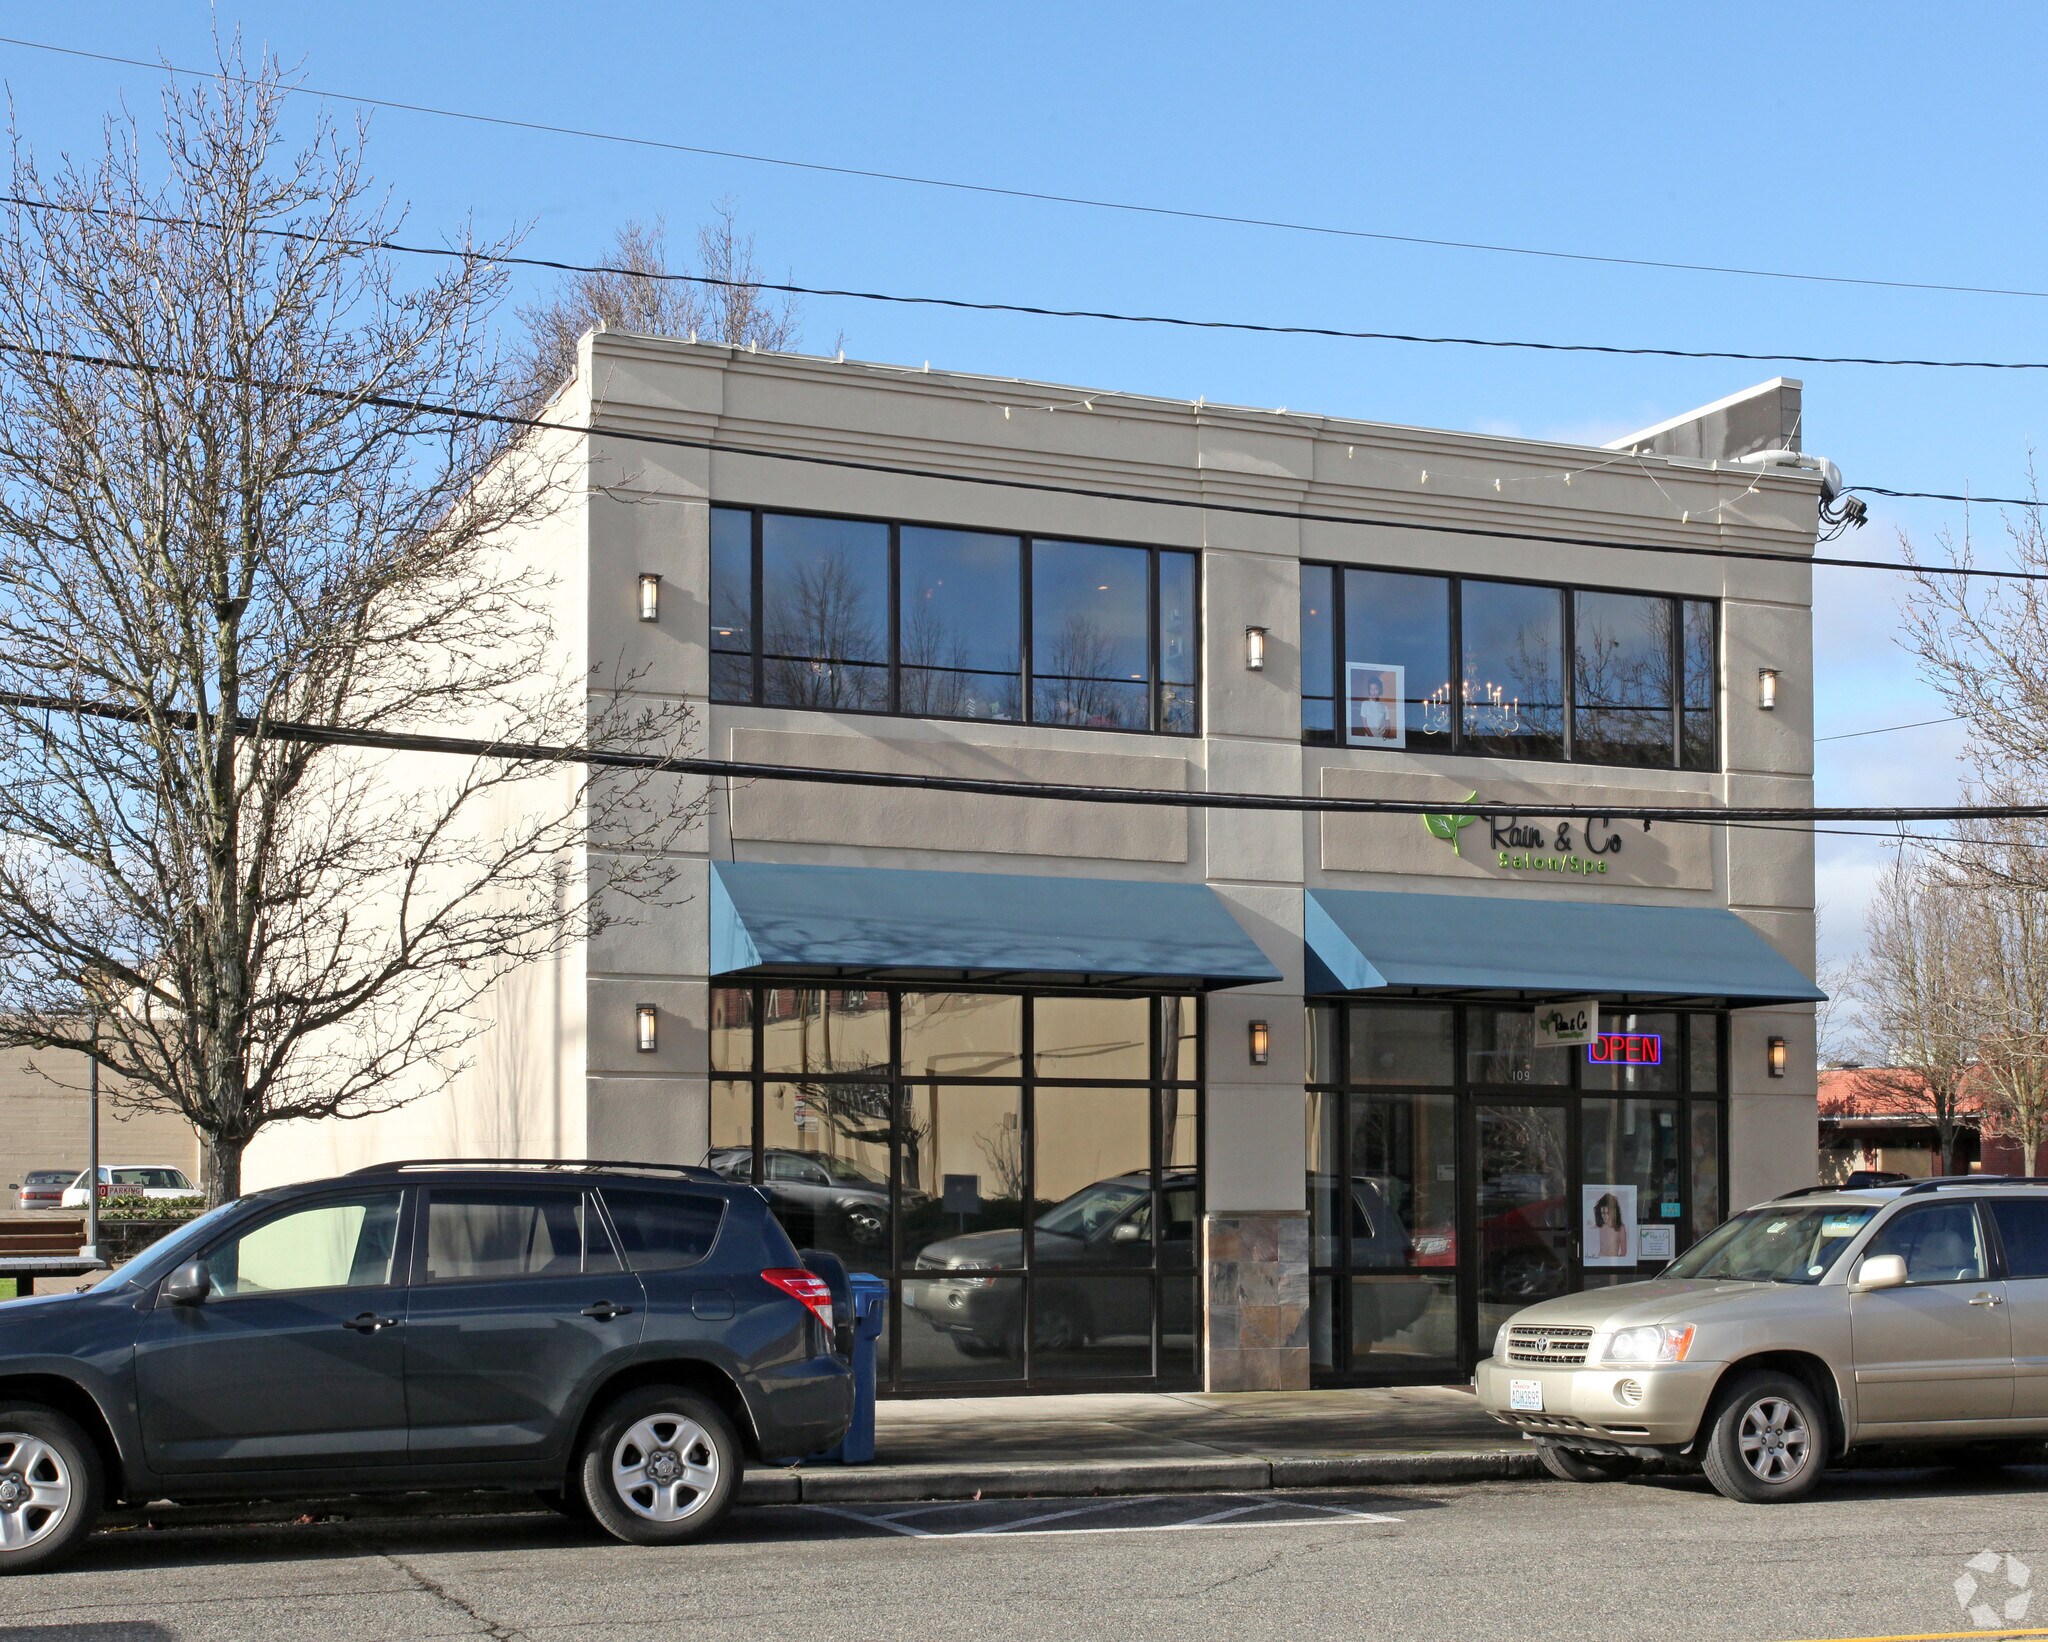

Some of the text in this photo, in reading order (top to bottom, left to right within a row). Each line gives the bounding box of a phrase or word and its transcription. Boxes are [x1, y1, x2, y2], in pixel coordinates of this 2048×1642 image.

[1480, 801, 1622, 854] Rain & Co
[1499, 851, 1608, 876] Salon/Spa
[1591, 1035, 1658, 1062] OPEN
[1512, 1070, 1530, 1081] 109
[109, 1187, 140, 1195] PARKING
